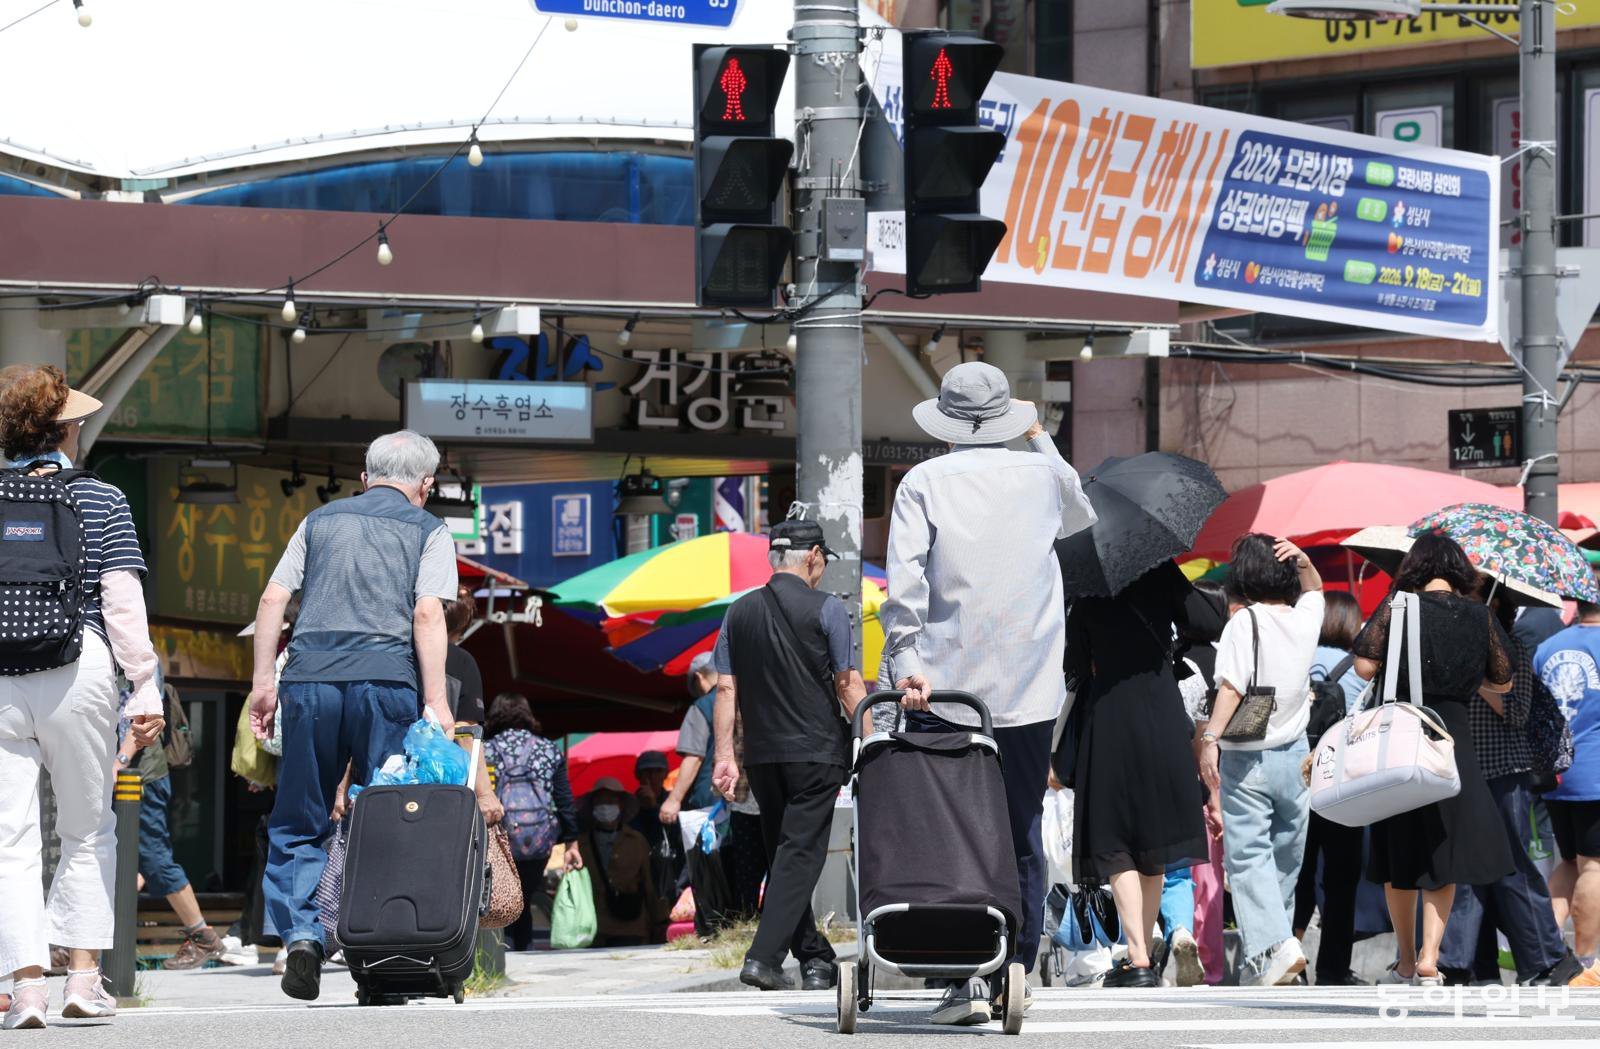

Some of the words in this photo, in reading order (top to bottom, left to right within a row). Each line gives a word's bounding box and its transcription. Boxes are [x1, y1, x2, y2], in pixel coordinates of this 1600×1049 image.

[584, 0, 685, 18] Dunchon-daero
[1231, 140, 1281, 187] 2026
[1278, 148, 1353, 197] 모란시장
[1396, 166, 1433, 193] 모란시장
[1217, 189, 1310, 241] 상권희망팩
[1406, 206, 1431, 228] 성남시
[1217, 258, 1242, 279] 성남시
[450, 393, 554, 421] 장수흑염소
[1454, 446, 1484, 460] 127m
